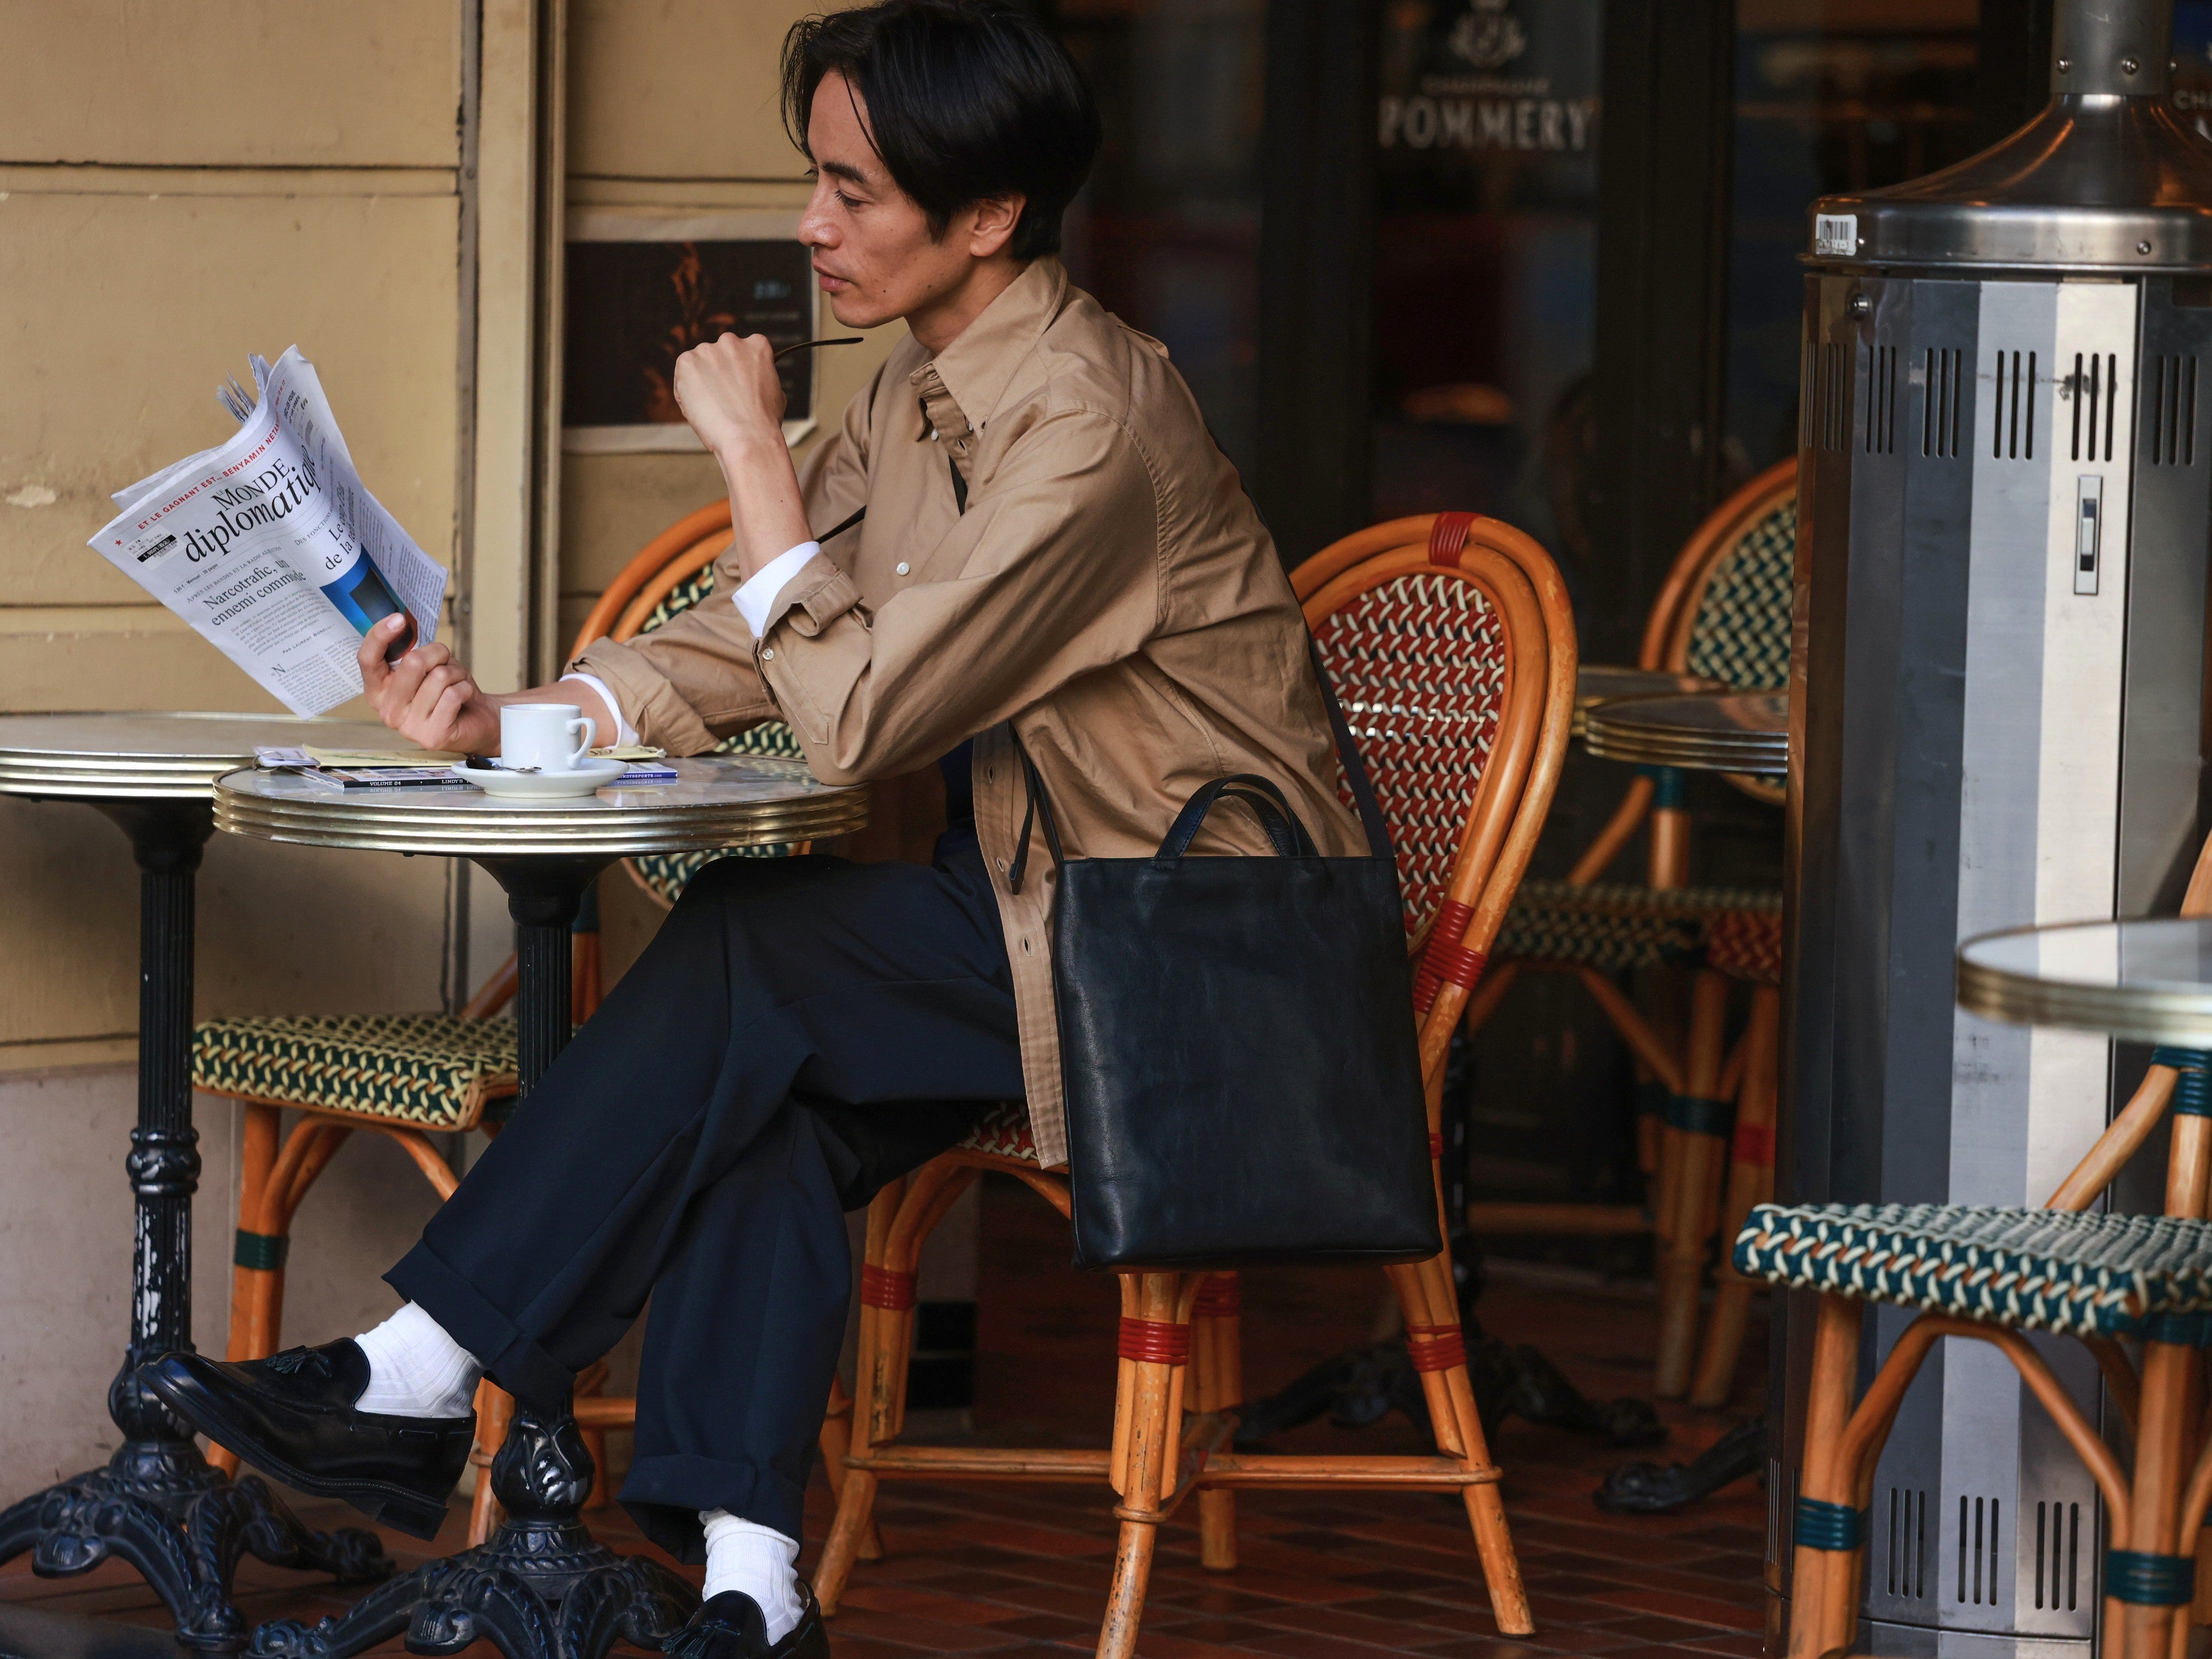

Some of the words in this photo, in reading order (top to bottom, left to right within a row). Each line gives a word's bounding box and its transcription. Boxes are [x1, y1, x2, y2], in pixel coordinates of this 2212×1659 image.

[1377, 96, 1596, 151] POMMERY
[138, 520, 149, 530] ET
[150, 512, 162, 522] LE
[163, 486, 200, 513] GAGNANT
[223, 445, 266, 477] BENYAMIN
[184, 445, 321, 562] diplomatique
[211, 458, 290, 511] MONDE
[215, 489, 225, 497] LE
[325, 554, 342, 570] de
[340, 541, 353, 555] la
[328, 523, 344, 542] Le
[203, 566, 278, 610] Narcotrafic,
[275, 559, 289, 569] un
[211, 593, 258, 626] ennemi
[257, 570, 306, 599] commode
[213, 572, 233, 585] BANDES
